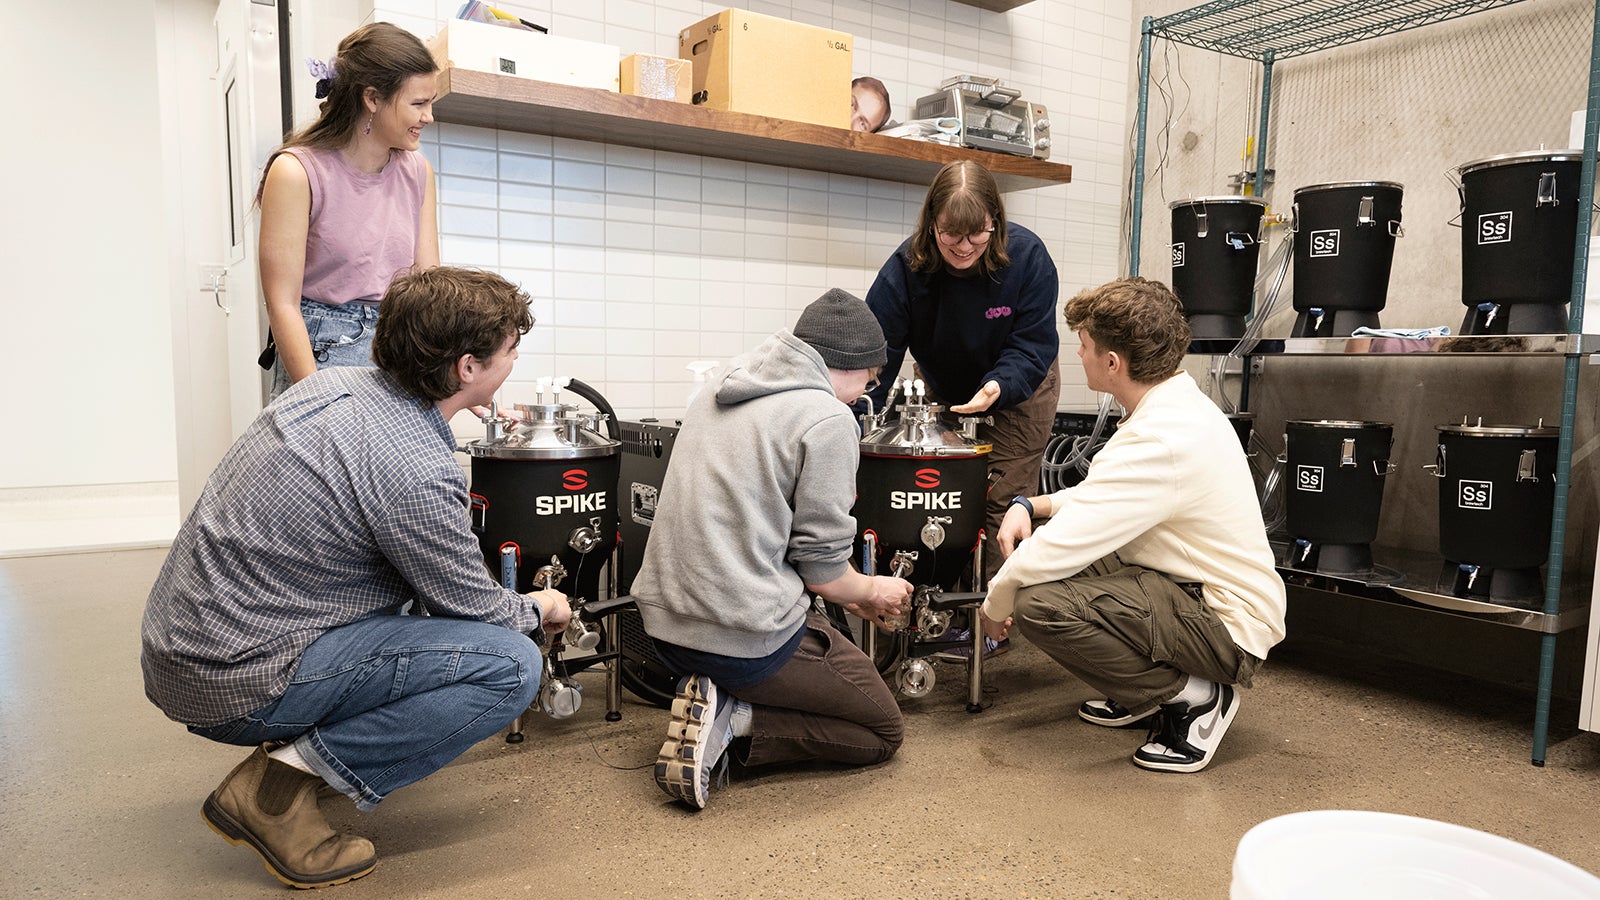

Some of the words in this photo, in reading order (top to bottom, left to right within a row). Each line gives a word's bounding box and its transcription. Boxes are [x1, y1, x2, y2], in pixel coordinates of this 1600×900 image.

[743, 22, 749, 31] 6
[1482, 220, 1506, 236] Ss
[1314, 236, 1335, 250] Ss
[1300, 470, 1319, 485] Ss
[890, 491, 962, 510] SPIKE
[1463, 486, 1486, 502] Ss
[536, 491, 607, 515] SPIKE
